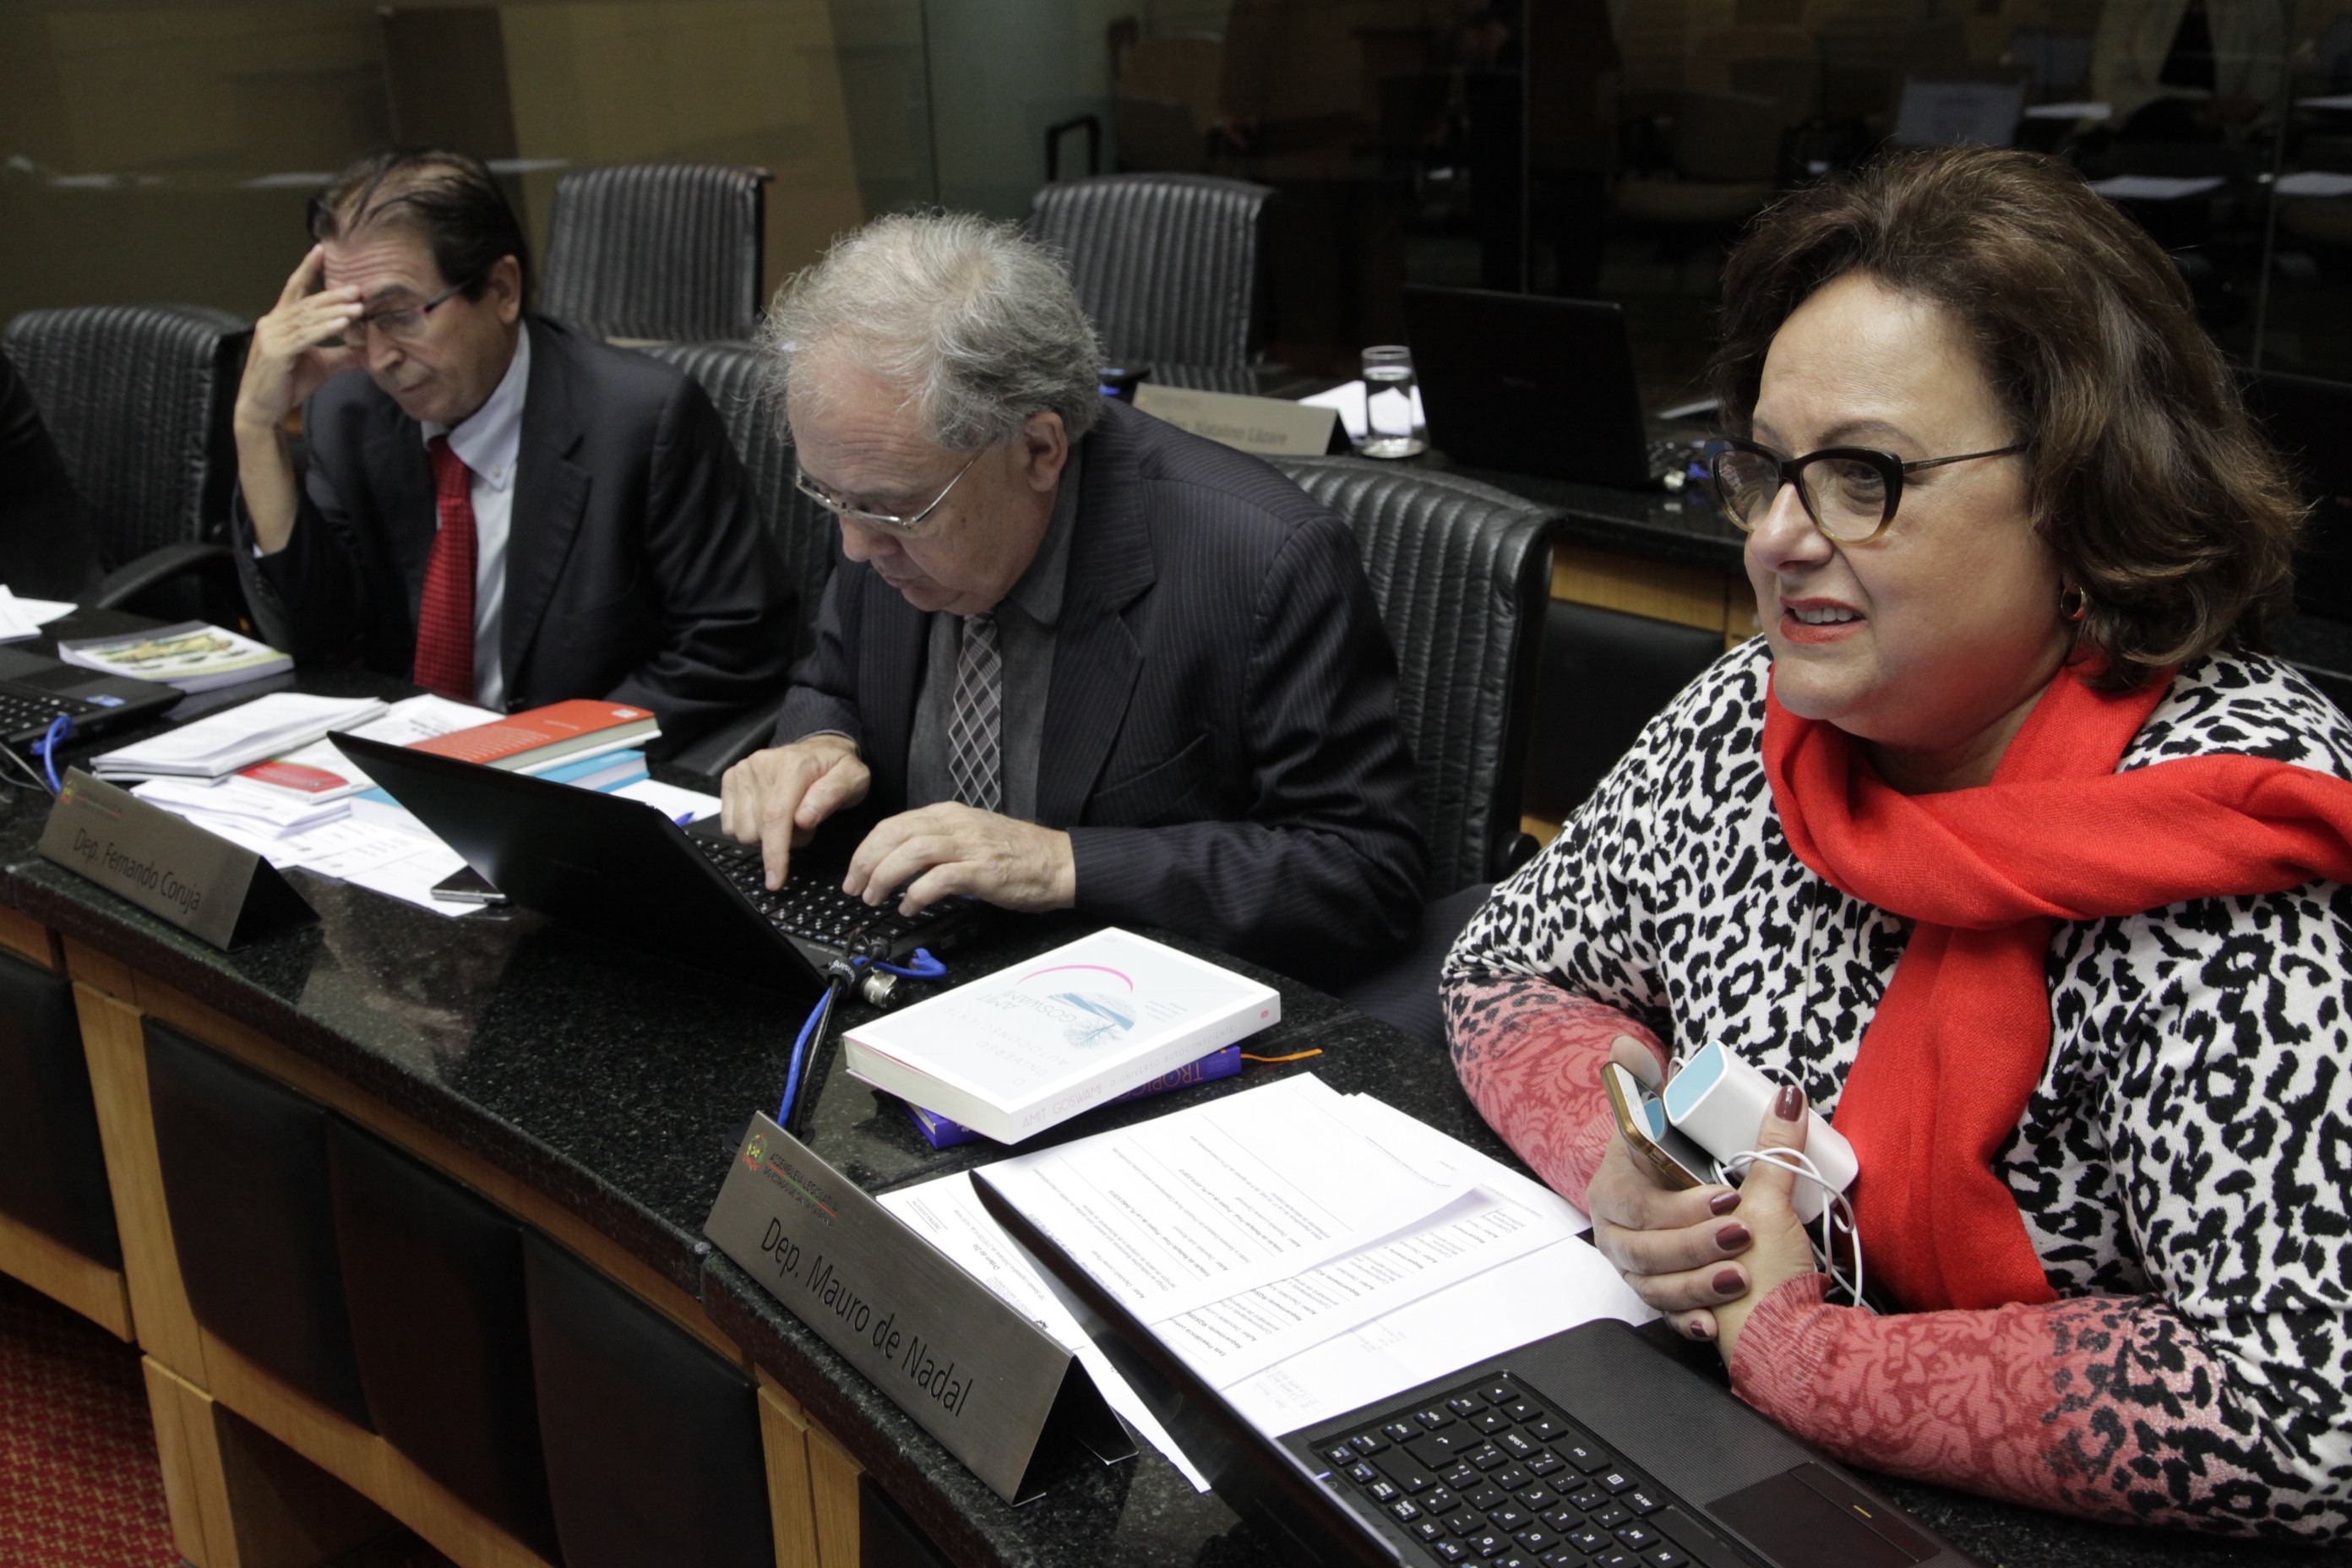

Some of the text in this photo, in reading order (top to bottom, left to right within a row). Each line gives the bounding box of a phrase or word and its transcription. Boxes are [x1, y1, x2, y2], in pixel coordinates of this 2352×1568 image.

[74, 828, 202, 916] Dep. Fernando Coruja
[998, 988, 1080, 1023] GOSWAMI
[1022, 1108, 1046, 1129] AMIT
[1053, 1082, 1102, 1115] GOSWAMI
[1119, 1058, 1160, 1083] UNIVERSO
[1163, 1024, 1233, 1064] AUTOCONSCIENTE
[760, 1217, 973, 1418] Dep. Mauro de Nadal
